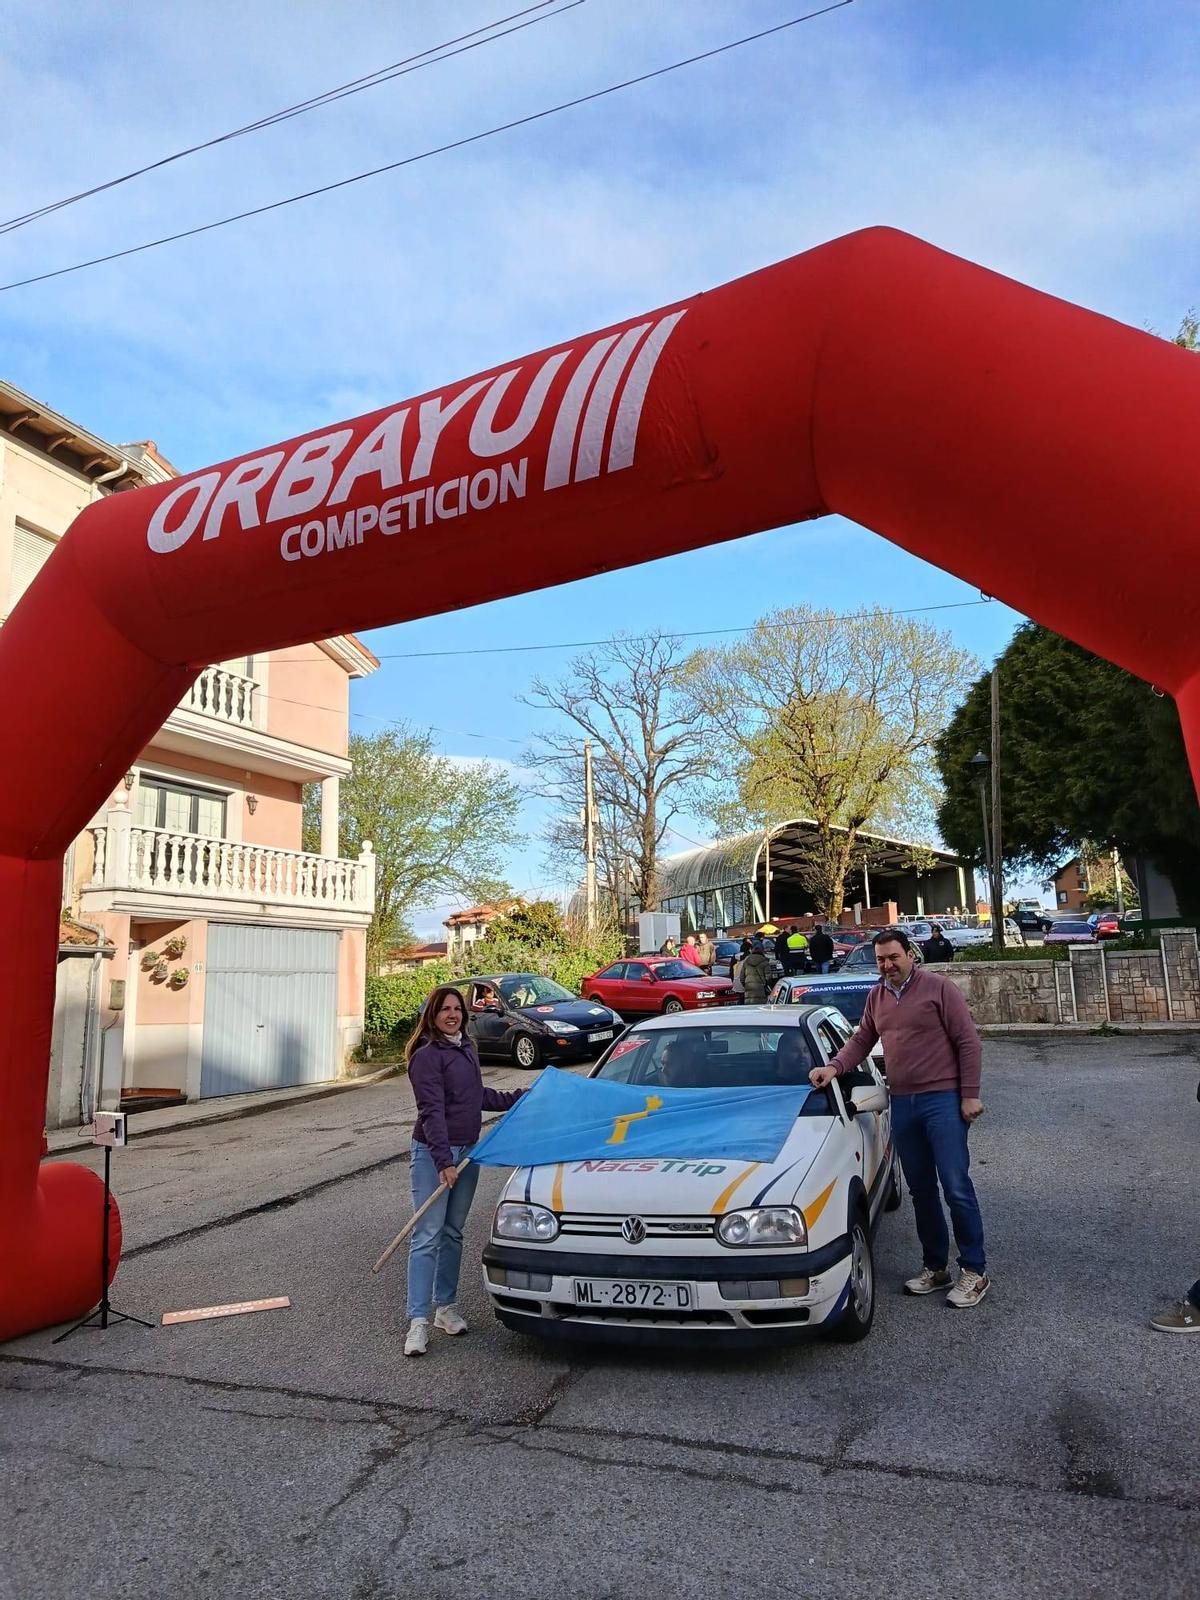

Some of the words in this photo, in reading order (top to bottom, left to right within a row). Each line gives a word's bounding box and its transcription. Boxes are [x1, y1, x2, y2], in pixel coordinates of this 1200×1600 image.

[146, 349, 574, 555] ORBAYU
[279, 457, 528, 562] COMPETICION
[572, 1159, 728, 1177] NacsTrip
